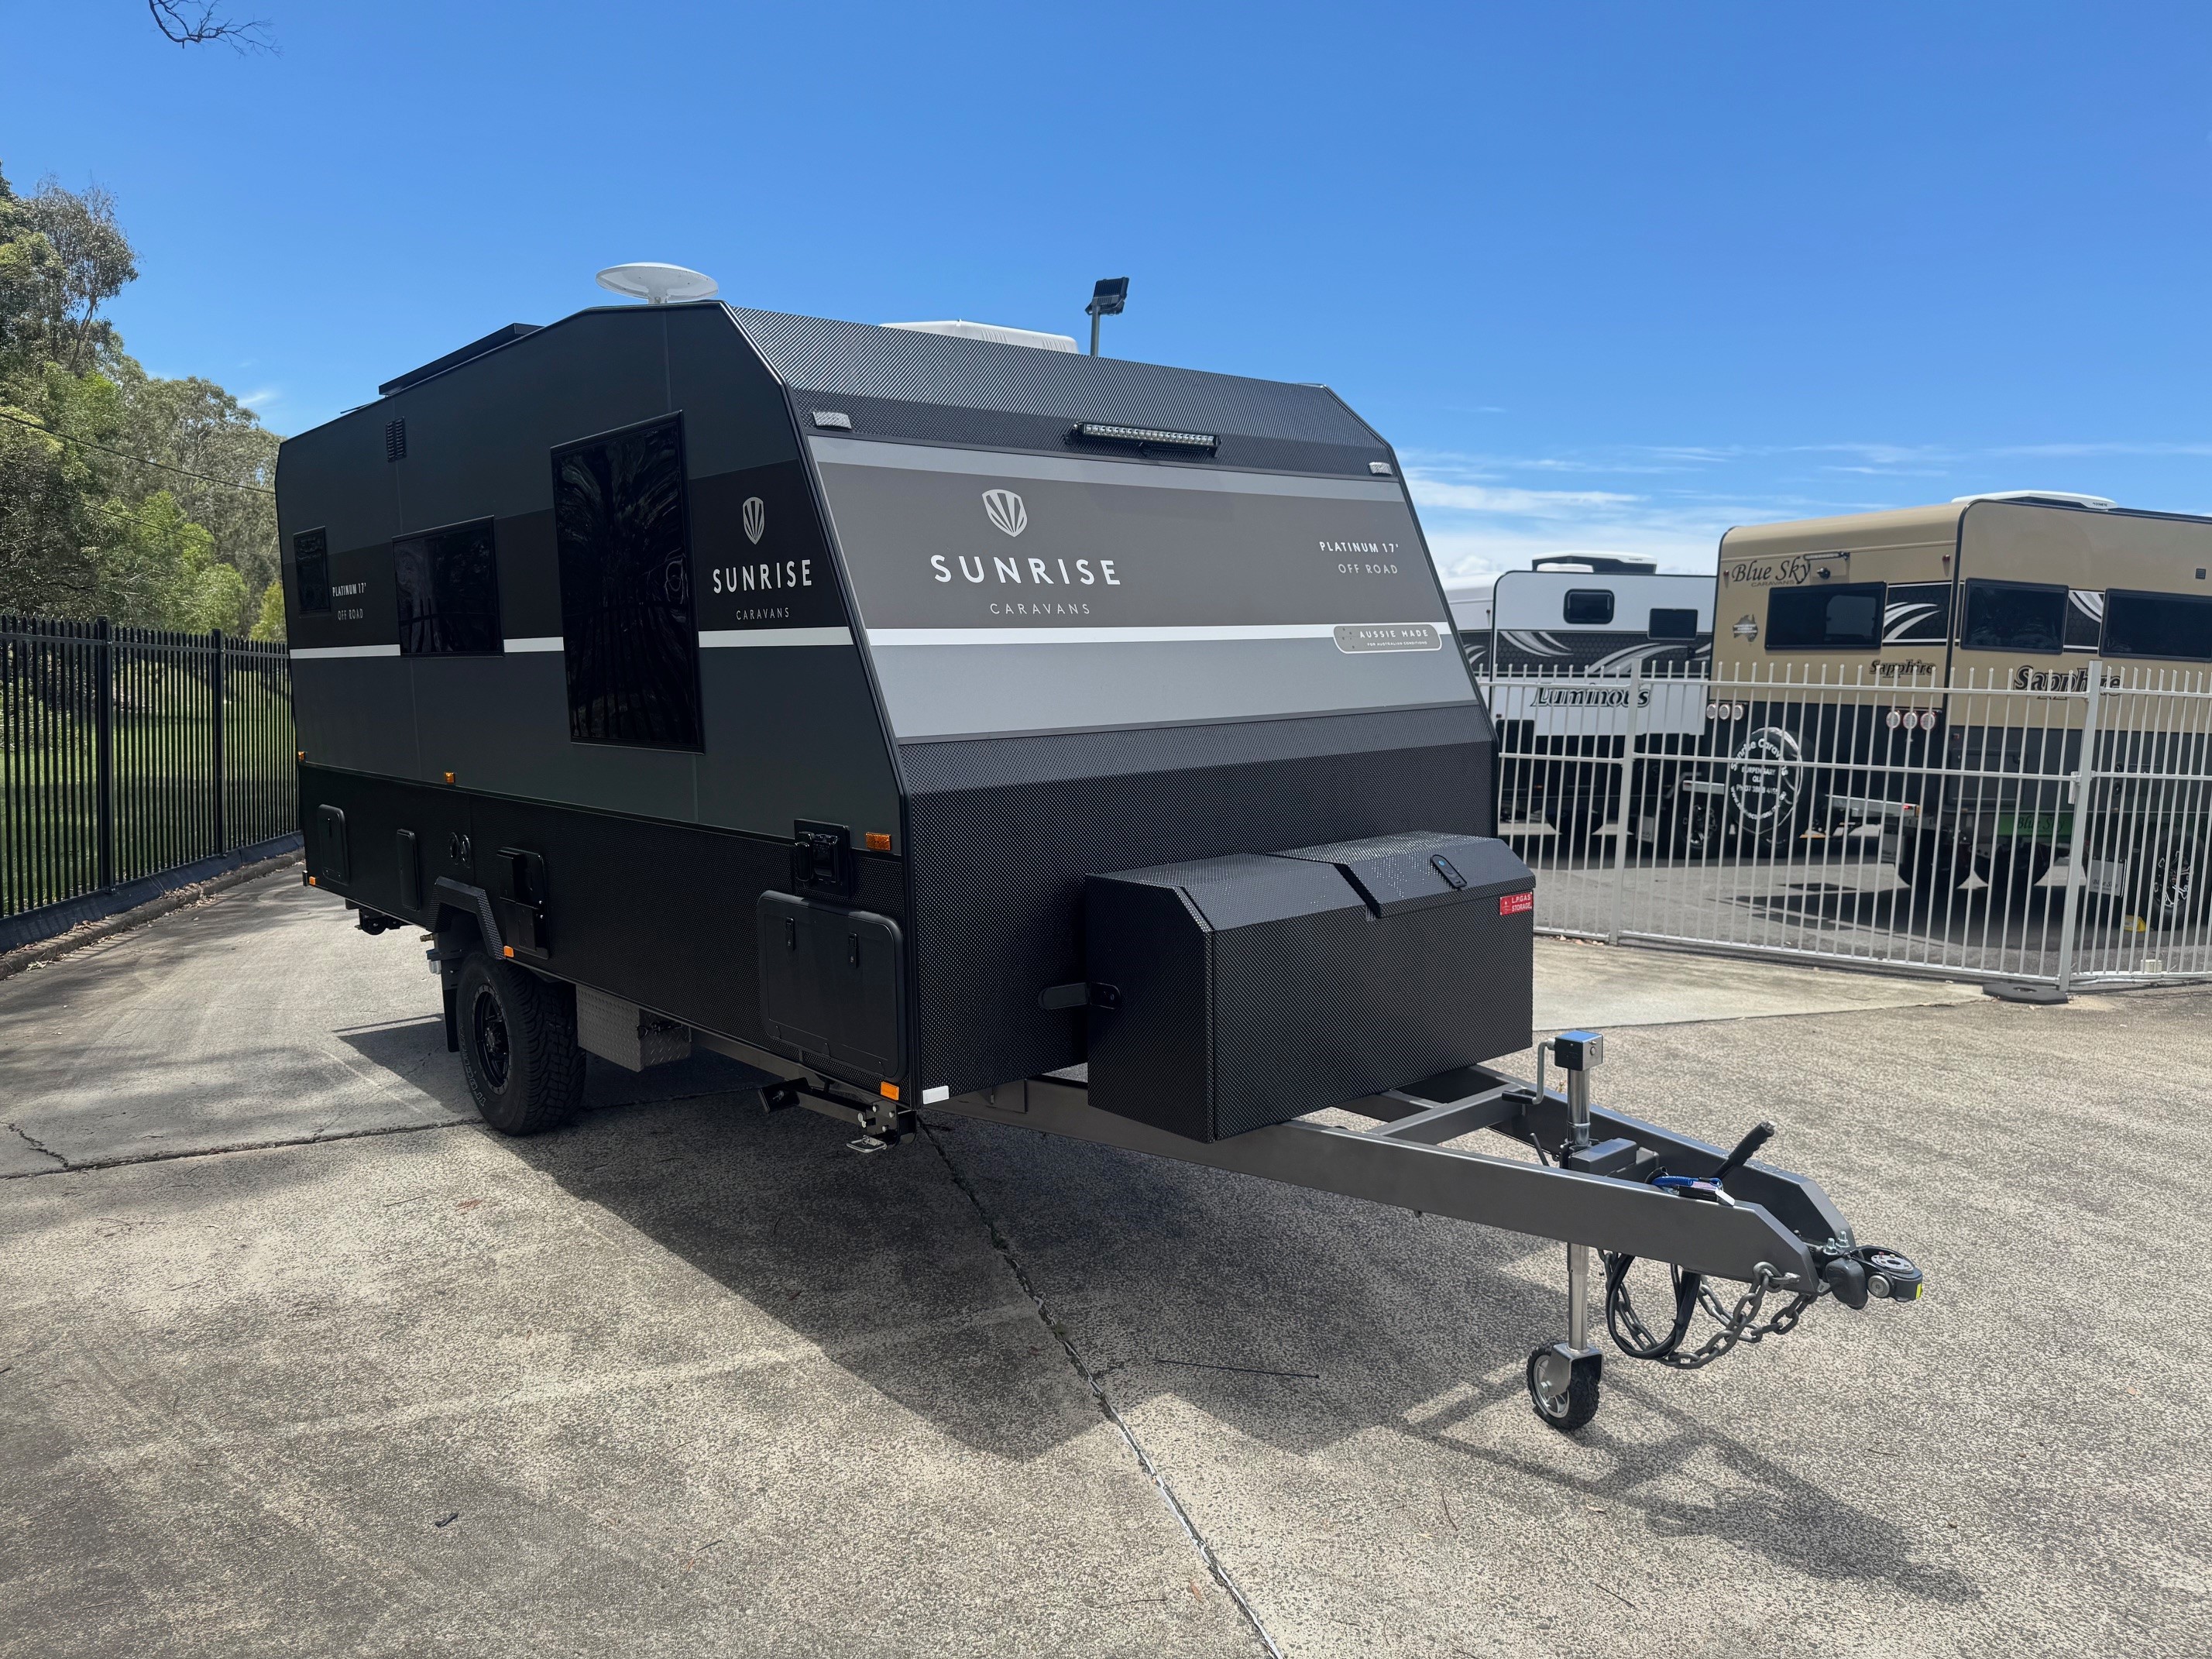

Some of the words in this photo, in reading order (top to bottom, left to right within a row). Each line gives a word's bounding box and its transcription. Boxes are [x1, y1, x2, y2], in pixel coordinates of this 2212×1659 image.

[1319, 541, 1379, 553] PLATINUM
[1382, 543, 1399, 553] 17'
[930, 555, 1121, 586] SUNRISE
[1338, 564, 1360, 574] OFF
[1365, 565, 1398, 574] ROAD
[1732, 560, 1772, 582] Blue
[1775, 556, 1811, 585] Sky
[713, 559, 812, 594] SUNRISE
[1751, 579, 1795, 588] CARAVANS
[332, 583, 357, 597] PLATINUM
[349, 608, 363, 620] ROAD
[736, 607, 789, 620] CARAVANS
[990, 603, 1091, 615] CARAVANS
[1359, 629, 1396, 639] AUSSIE
[1401, 629, 1429, 638] MADE
[2014, 665, 2124, 700] Sapphre
[1511, 902, 1531, 912] STORAGE
